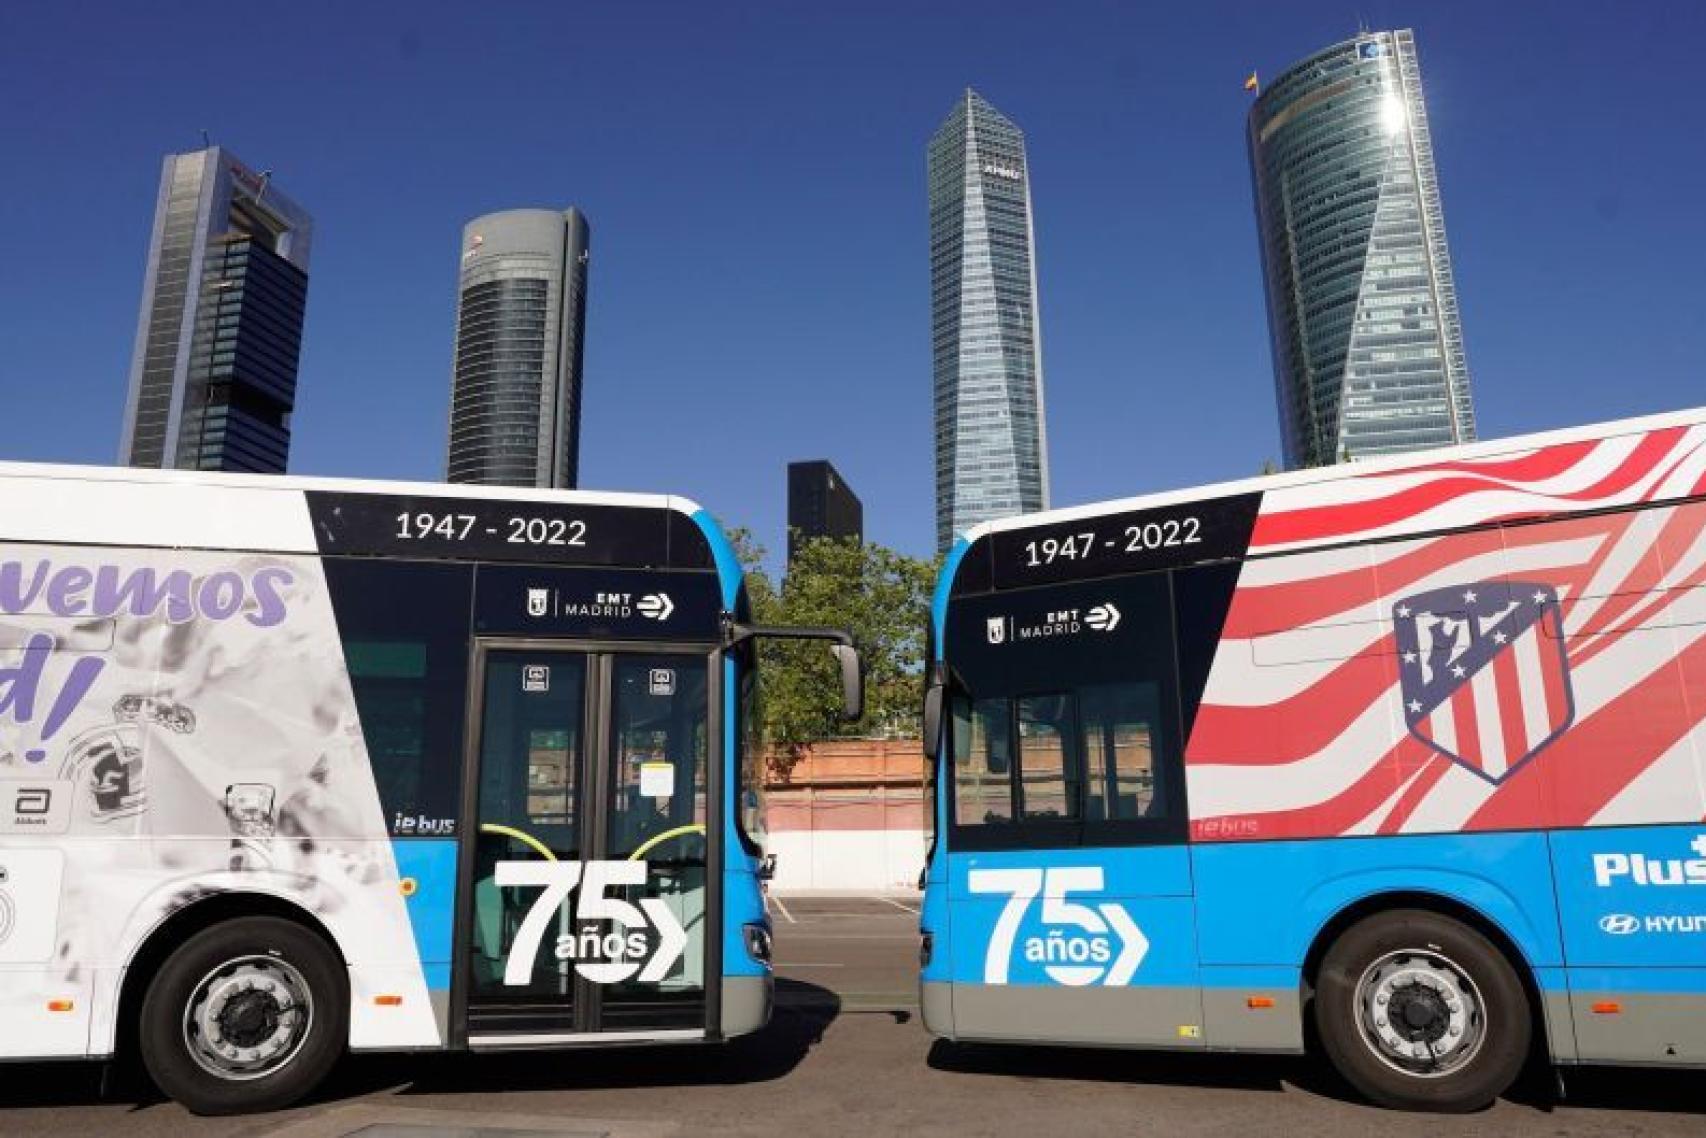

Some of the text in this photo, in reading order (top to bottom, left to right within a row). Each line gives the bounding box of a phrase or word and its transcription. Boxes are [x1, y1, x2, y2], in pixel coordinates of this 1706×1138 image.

[396, 511, 476, 541] 1947
[506, 517, 587, 546] 2022
[1024, 532, 1096, 567] 1947
[1124, 517, 1202, 552] 2022
[0, 558, 294, 628] vemos
[596, 592, 632, 605] EMT
[565, 603, 632, 618] MADRID
[1047, 608, 1080, 623] EMT
[1019, 620, 1081, 638] MADRID
[494, 860, 649, 986] 75
[967, 866, 1110, 987] 75
[555, 925, 648, 959] años
[1025, 929, 1111, 963] años
